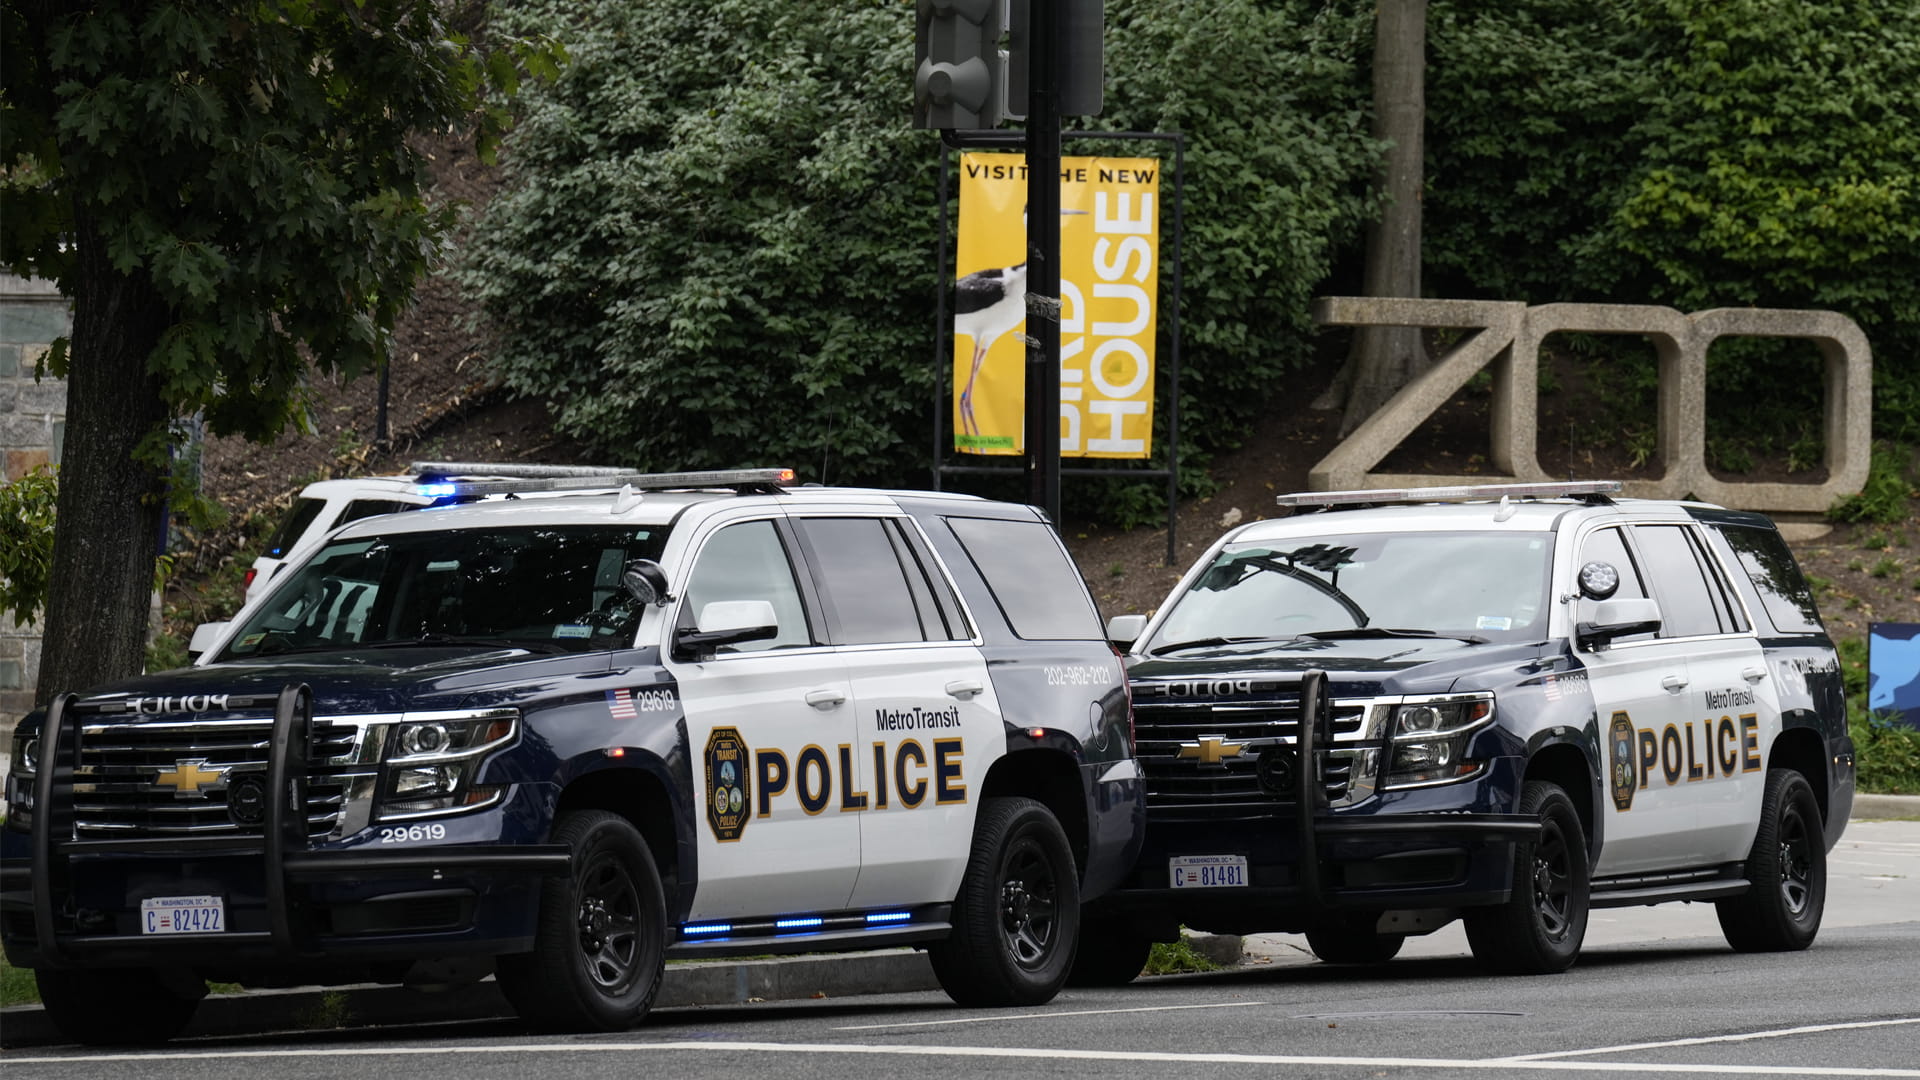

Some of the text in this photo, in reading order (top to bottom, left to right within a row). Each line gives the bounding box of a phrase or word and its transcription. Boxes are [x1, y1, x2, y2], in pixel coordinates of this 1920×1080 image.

[966, 163, 1155, 184] VISIT HE NEW
[1087, 191, 1153, 453] HOUSE
[1309, 297, 1873, 511] ZOO
[1044, 666, 1112, 685] 202-962-2121
[637, 689, 675, 711] 29619
[1704, 685, 1755, 711] MetroTransit
[876, 706, 960, 731] MetroTransit
[716, 749, 738, 760] TRANSIT
[1638, 713, 1762, 790] POLICE
[755, 737, 967, 819] POLICE
[381, 823, 446, 843] 29619
[719, 816, 738, 827] POLICE
[1175, 865, 1243, 887] C 81481
[147, 908, 220, 933] C 82422
